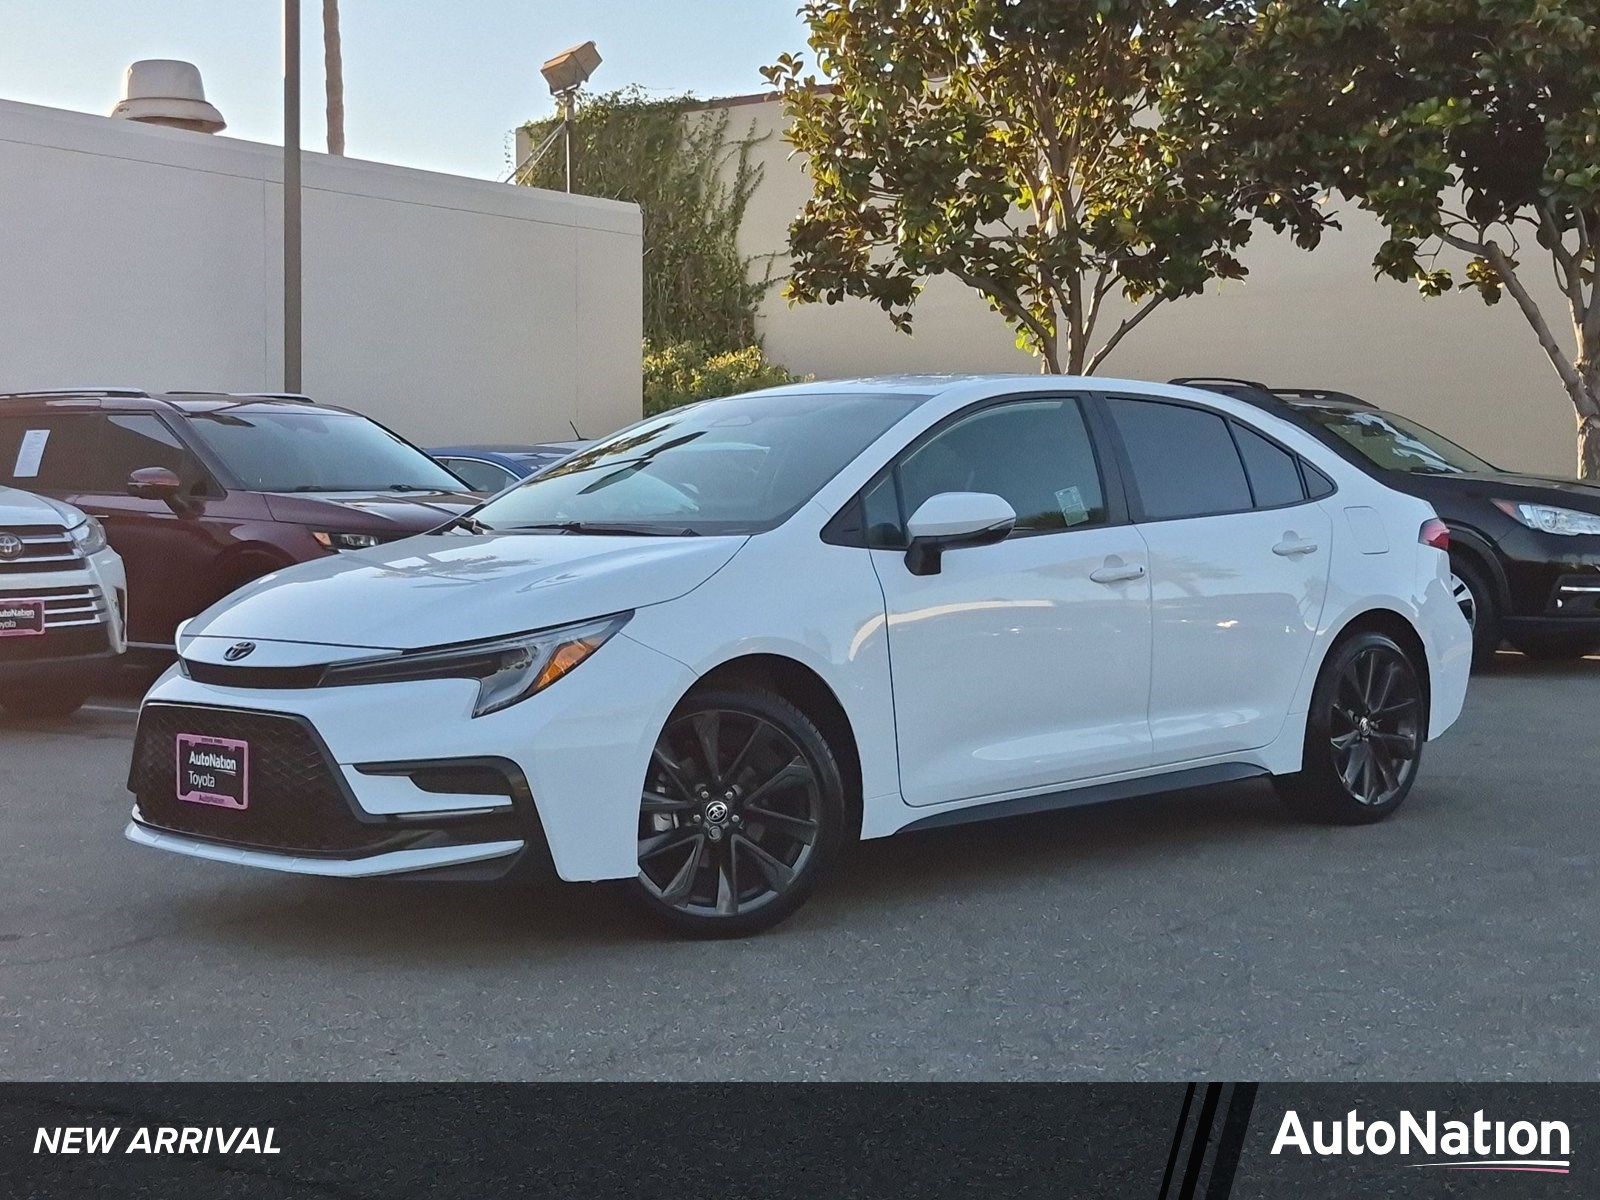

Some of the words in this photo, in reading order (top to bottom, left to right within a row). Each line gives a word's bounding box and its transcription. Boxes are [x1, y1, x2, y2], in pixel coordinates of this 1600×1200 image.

[0, 608, 35, 618] utoNation
[188, 751, 236, 771] AutoNation
[188, 770, 215, 788] Toyota
